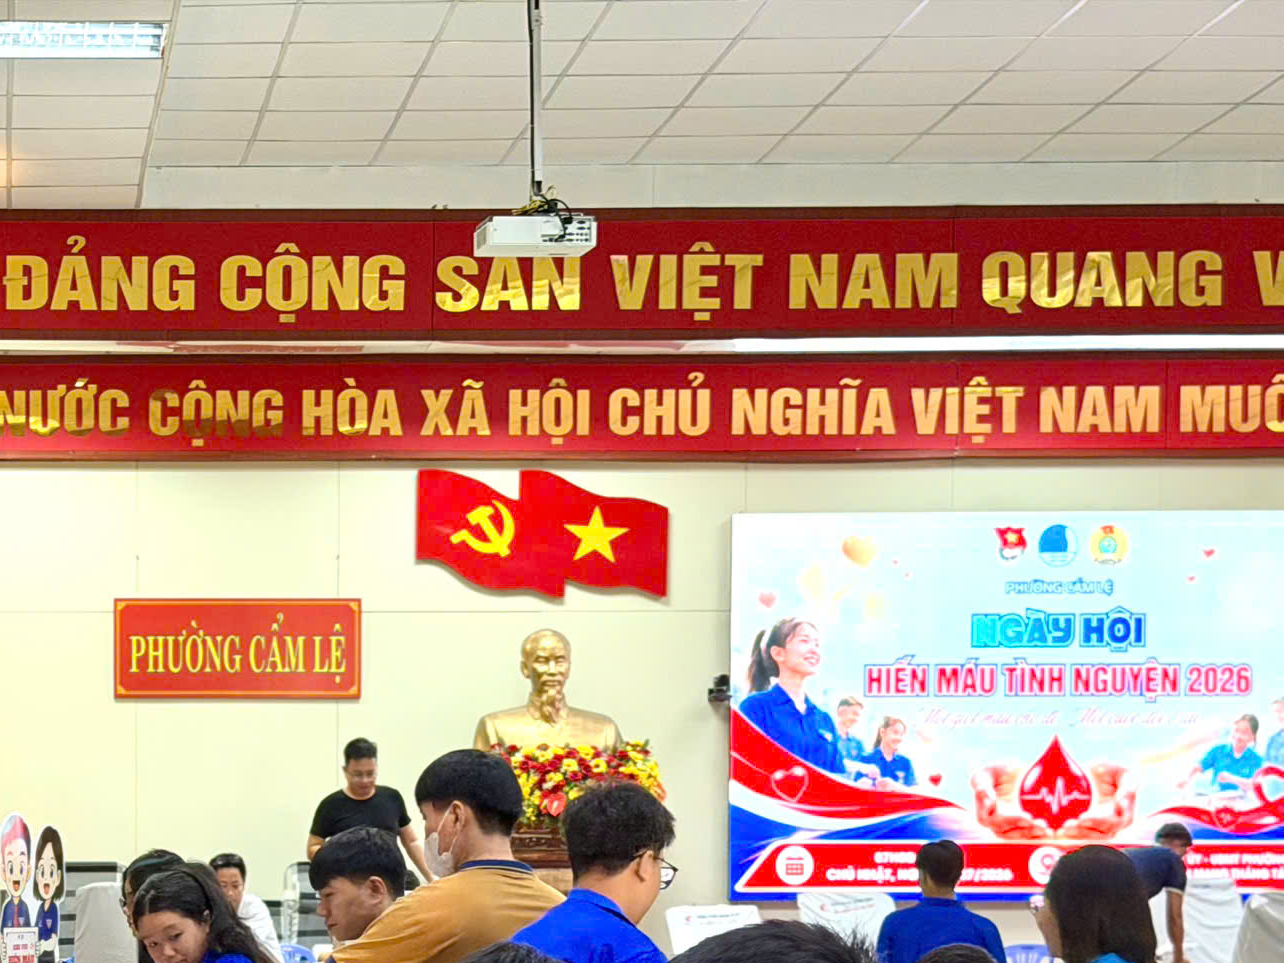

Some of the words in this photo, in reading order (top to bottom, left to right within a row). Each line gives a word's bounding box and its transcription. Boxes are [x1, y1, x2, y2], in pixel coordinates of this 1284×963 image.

[3, 235, 196, 312] ĐẢNG
[219, 243, 406, 323] CỘNG
[610, 242, 764, 321] VIỆT
[789, 252, 959, 310] NAM
[980, 250, 1224, 315] QUANG
[148, 379, 284, 447] CỘNG
[301, 377, 404, 438] HÒA
[420, 379, 491, 437] XÃ
[508, 378, 591, 446] HỘI
[608, 371, 712, 437] CHỦ
[731, 378, 897, 436] NGHĨA
[911, 375, 1024, 444] VIỆT
[1039, 385, 1161, 435] NAM
[129, 619, 242, 674] PHƯỜNG
[249, 612, 306, 674] CẨM
[313, 622, 347, 684] LỆ
[971, 607, 1076, 648] NGÀY
[1079, 605, 1146, 652] HỘI
[934, 657, 998, 697] MÁU
[1001, 657, 1066, 697] TÌNH
[1070, 656, 1180, 703] NGUYỆN
[1185, 663, 1253, 696] 2026
